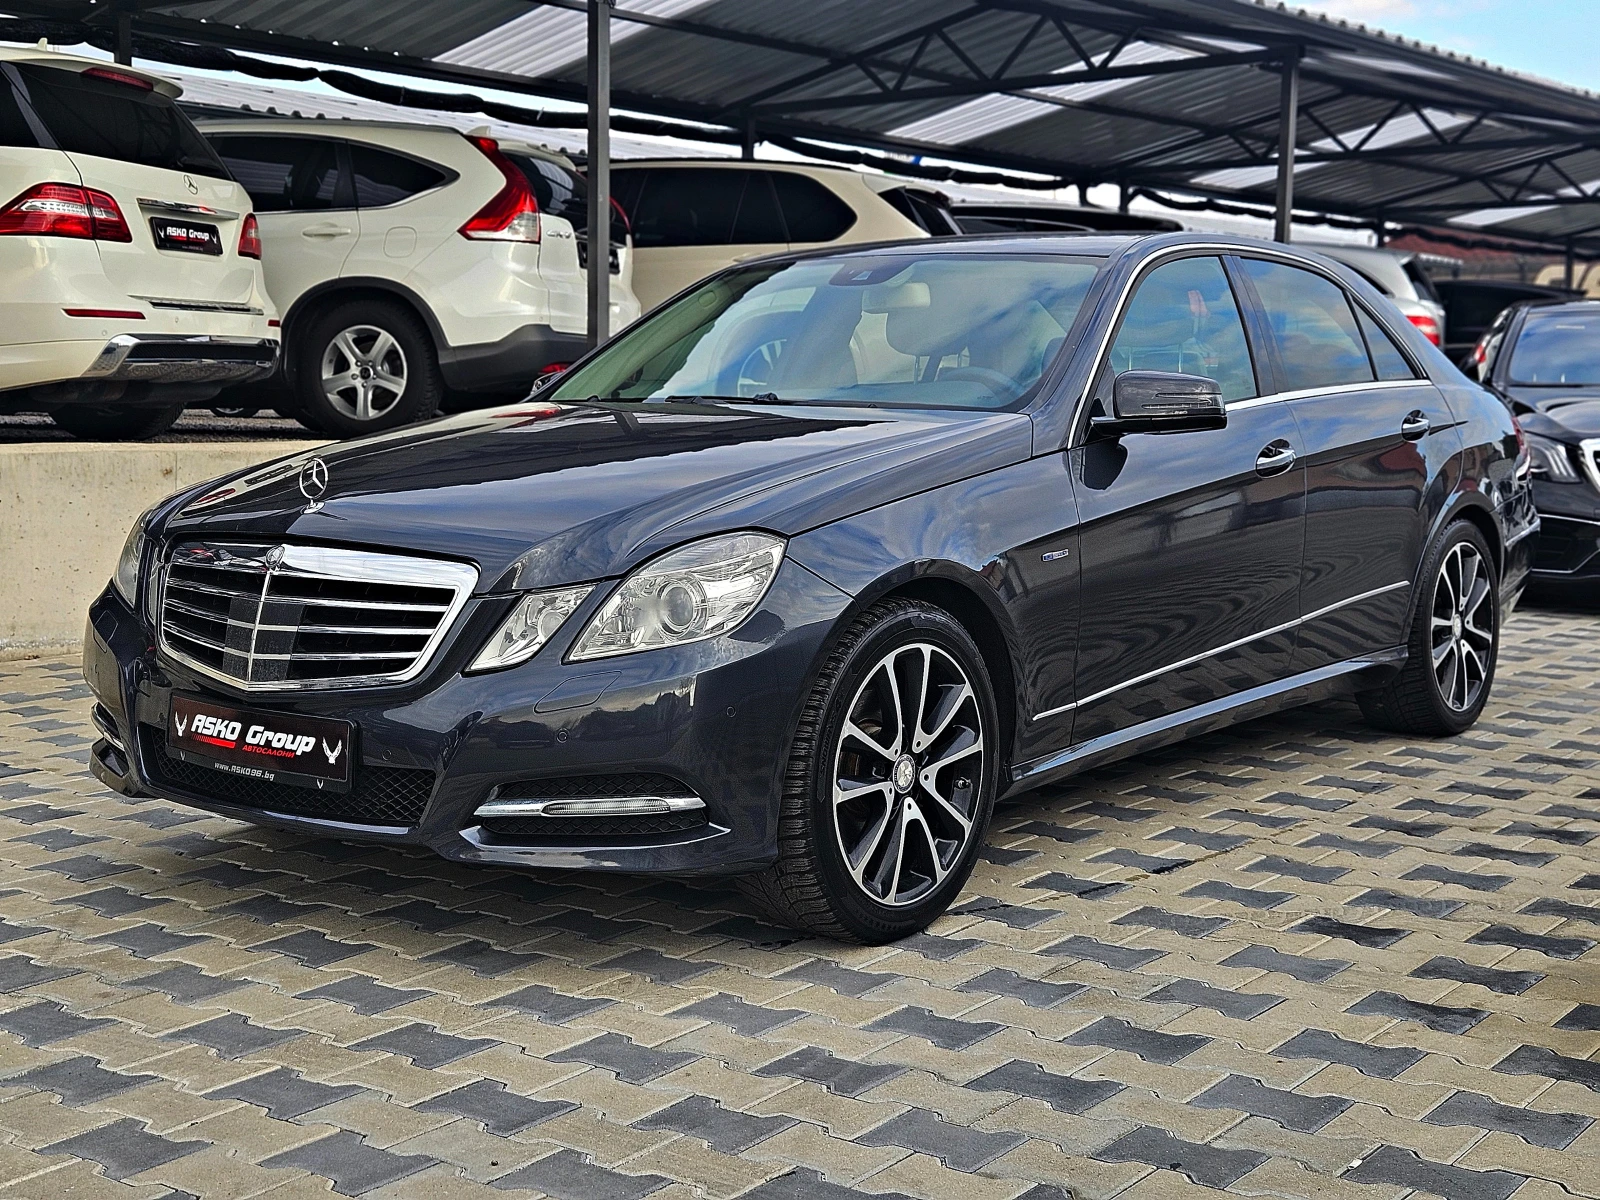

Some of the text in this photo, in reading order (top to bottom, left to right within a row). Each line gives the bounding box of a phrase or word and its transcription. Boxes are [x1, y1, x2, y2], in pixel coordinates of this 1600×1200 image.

[166, 226, 209, 241] ASKO Group
[190, 713, 316, 756] ASKO Group
[242, 744, 295, 758] АВТОСАЛОНИ
